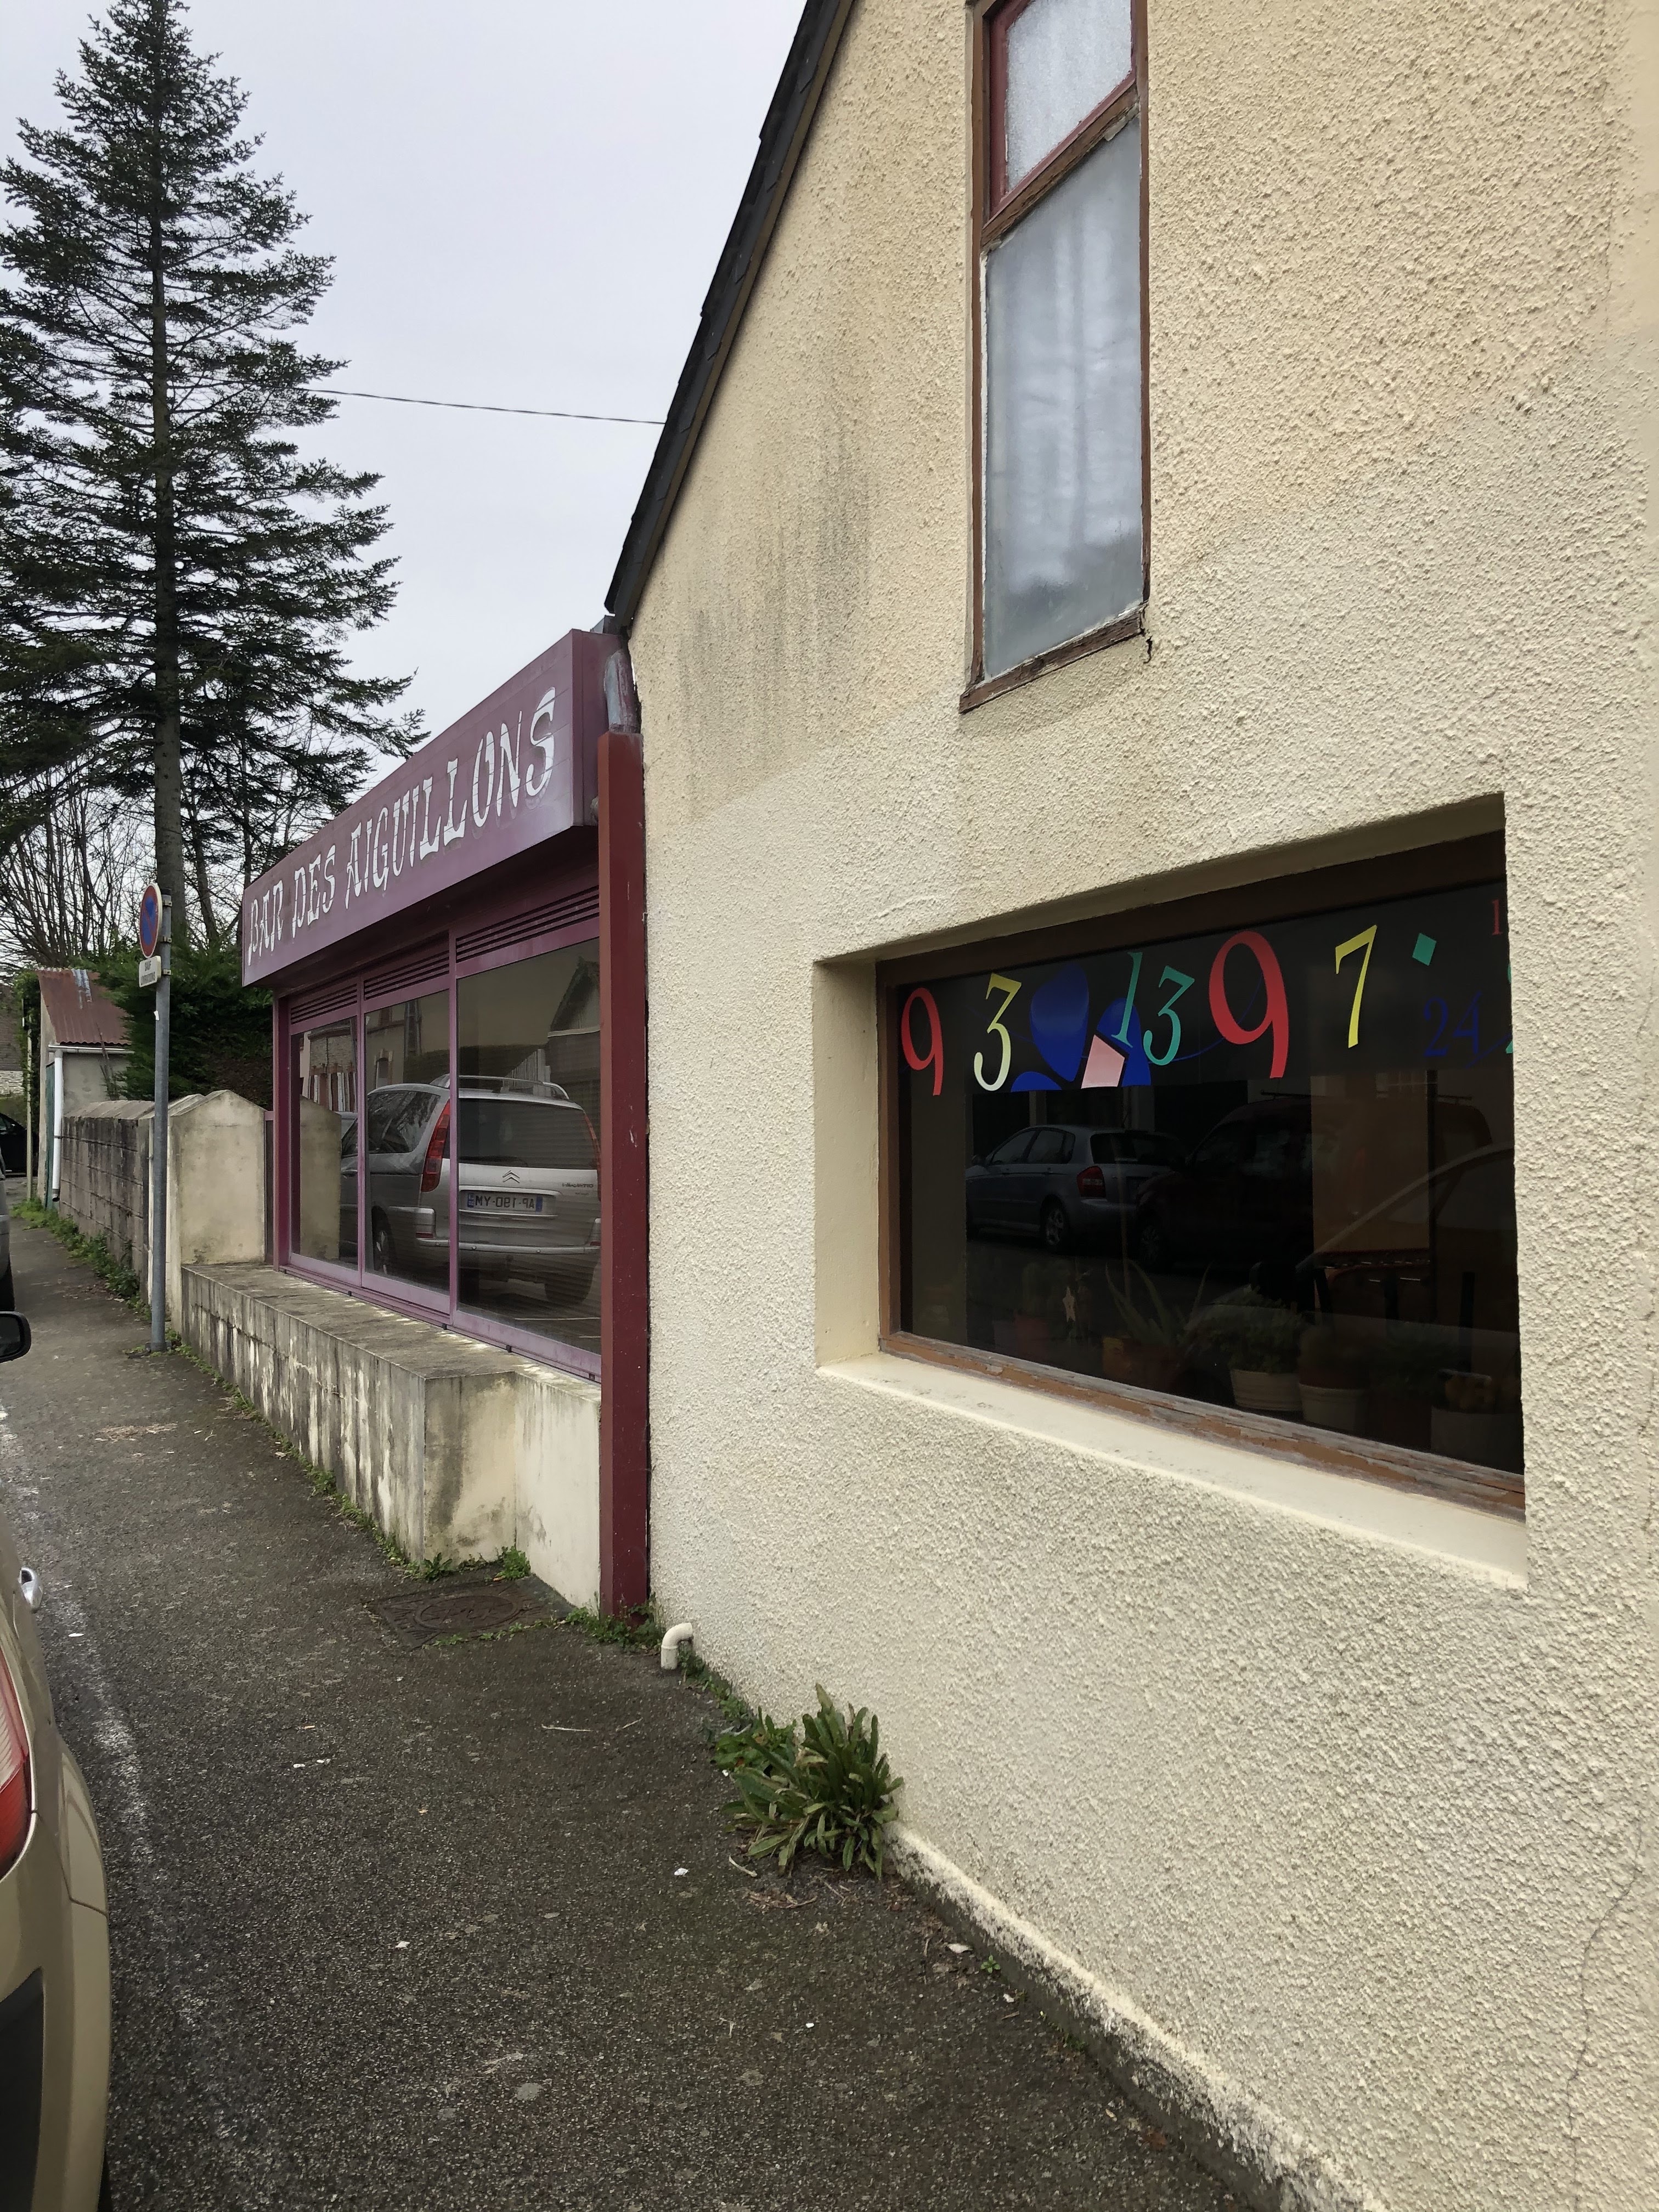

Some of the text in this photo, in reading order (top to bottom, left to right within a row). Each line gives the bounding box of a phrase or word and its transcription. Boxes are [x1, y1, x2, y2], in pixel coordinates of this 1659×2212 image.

[248, 686, 556, 967] BAR DES AIGUILLONS
[900, 987, 944, 1096] 9
[973, 973, 1022, 1092] 3
[1208, 930, 1290, 1079] 9
[1334, 924, 1378, 1049] 7
